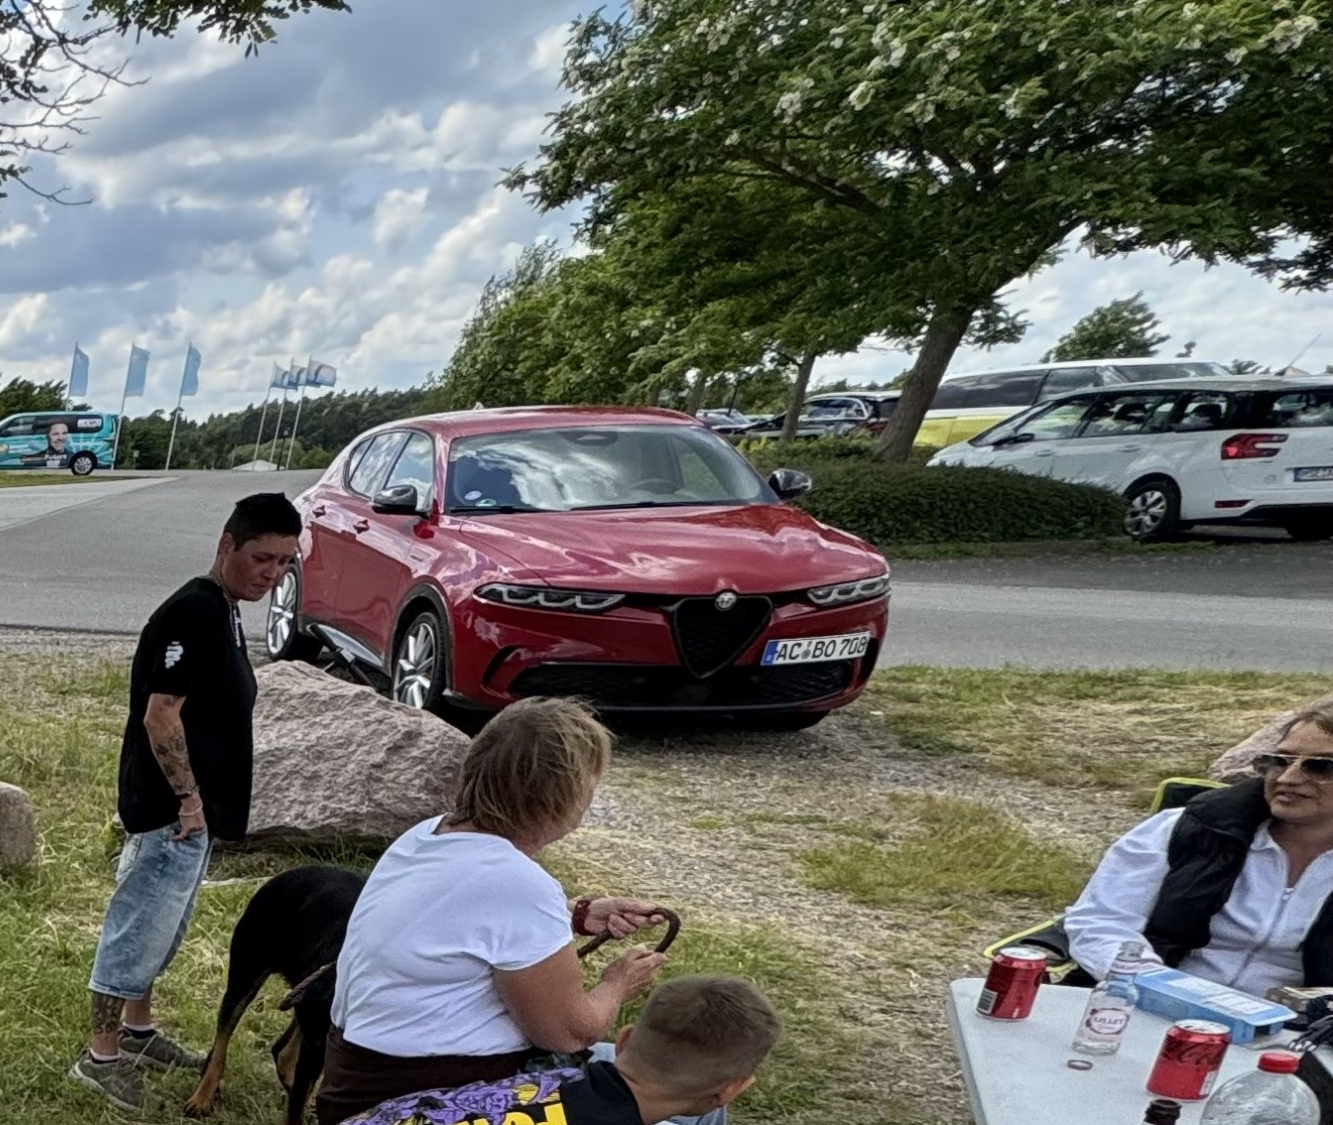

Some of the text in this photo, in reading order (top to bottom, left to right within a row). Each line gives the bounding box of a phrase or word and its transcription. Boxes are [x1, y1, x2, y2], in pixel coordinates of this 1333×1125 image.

[776, 635, 868, 661] AC BO 708
